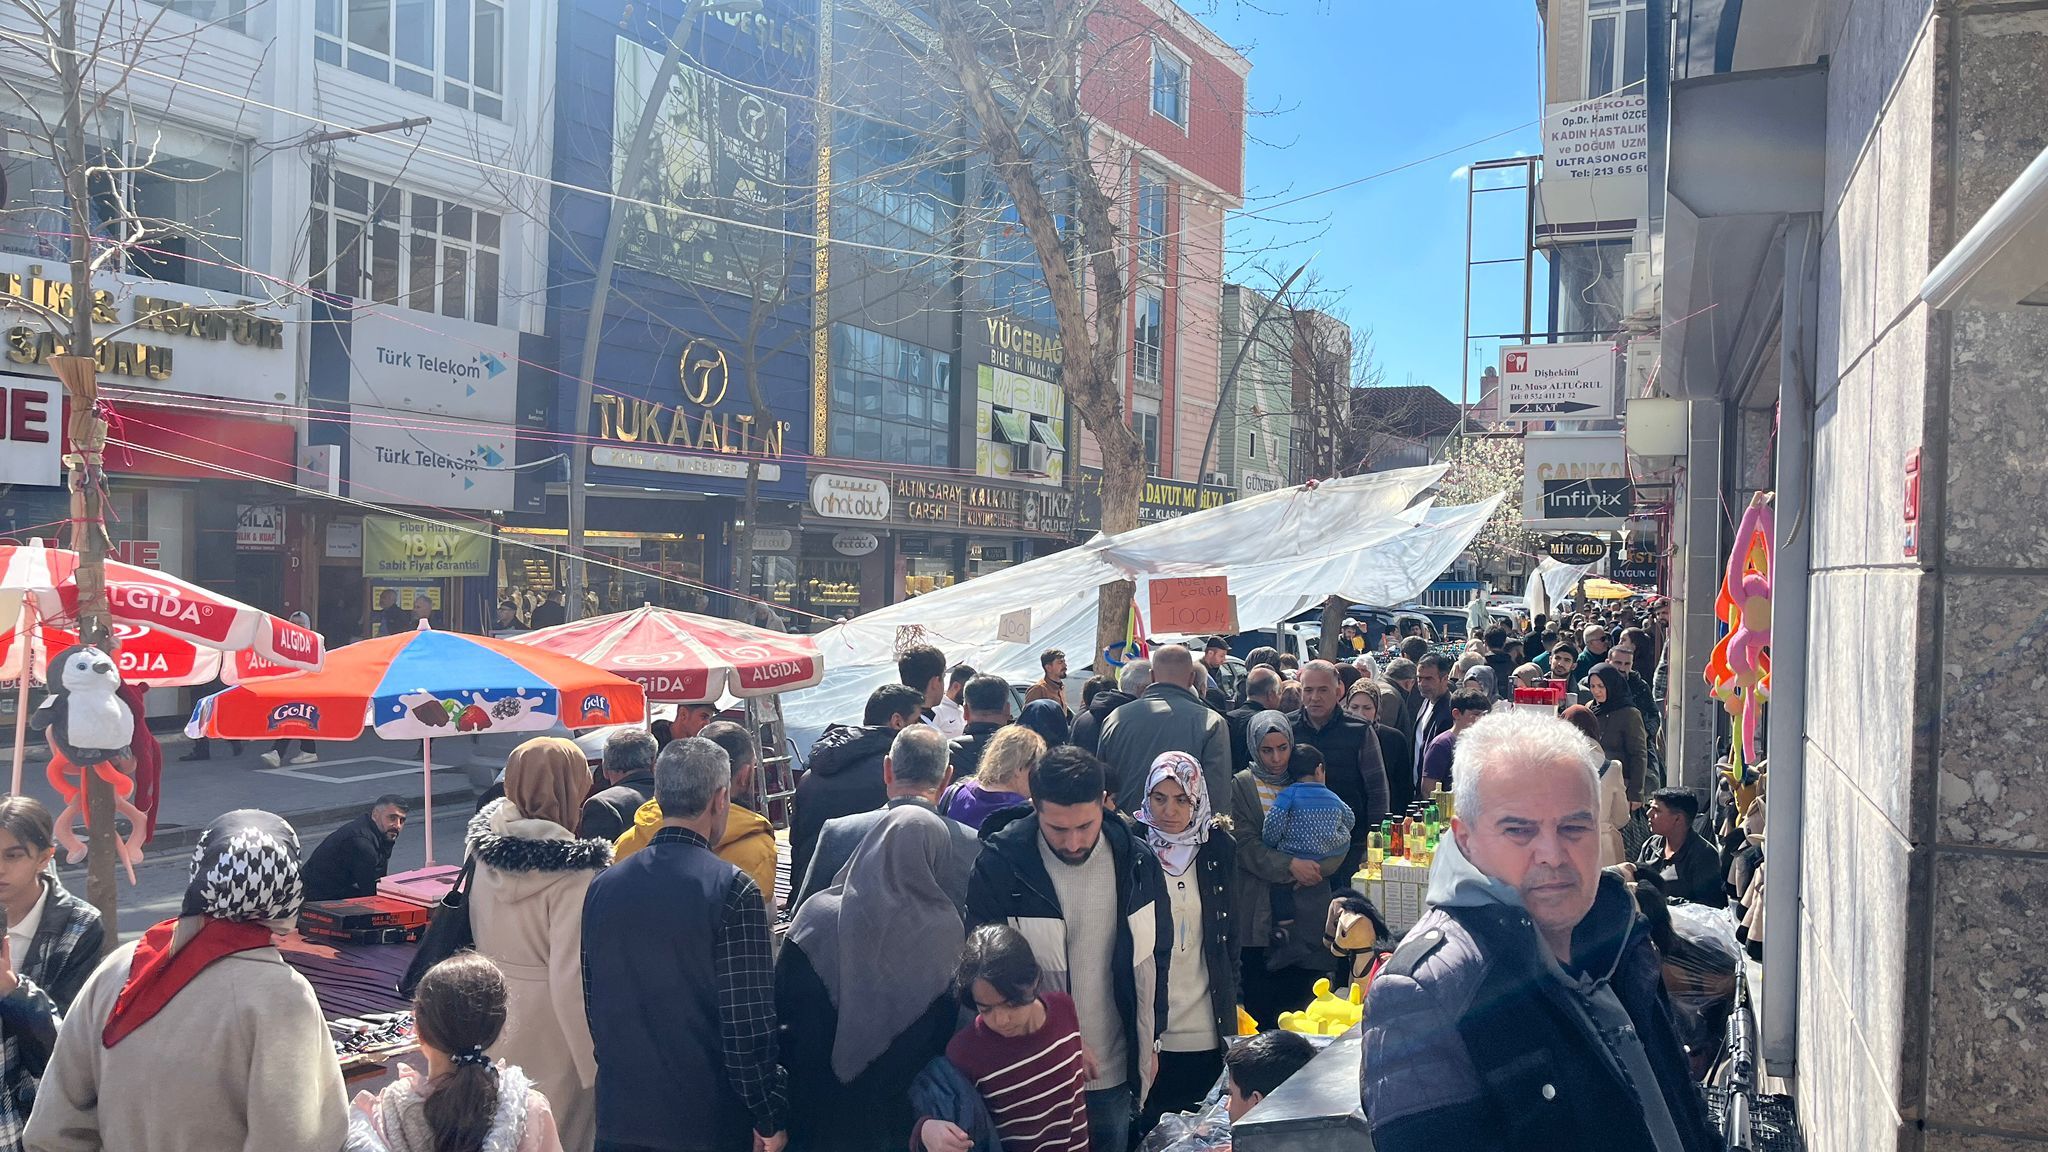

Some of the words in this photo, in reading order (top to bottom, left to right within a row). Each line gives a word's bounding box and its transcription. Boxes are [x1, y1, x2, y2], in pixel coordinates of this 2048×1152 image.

[1562, 115, 1589, 127] Op.Dr.
[1592, 112, 1619, 123] Hamit
[1551, 130, 1587, 141] KADIN
[1590, 123, 1646, 138] HASTALIK
[1560, 146, 1572, 154] ve
[1575, 140, 1615, 153] DOĞUM
[1621, 137, 1646, 148] UZM
[1556, 151, 1647, 167] ULTRASONOGR
[1570, 169, 1591, 178] Tel:
[1594, 166, 1614, 176] 213
[1618, 165, 1632, 174] 65
[986, 315, 1063, 365] YÜCEBAĞ
[7, 325, 174, 381] SAONU
[991, 347, 1024, 372] BİLEİK
[376, 346, 412, 369] Türk
[417, 353, 481, 379] Telekom
[1534, 367, 1579, 379] Dişhekimi
[1549, 380, 1604, 390] ALTUĞRUL
[1536, 403, 1559, 412] KAT
[375, 446, 410, 465] Türk
[415, 450, 479, 472] Telekom
[899, 480, 926, 497] ALTIN
[928, 482, 962, 501] SARAY
[969, 486, 1017, 510] KALKAN
[1146, 482, 1181, 508] DAVUT
[1550, 489, 1622, 507] Infinix
[400, 521, 425, 532] Fiber
[401, 534, 427, 557] 18
[431, 534, 461, 557] AY
[1551, 542, 1574, 555] MİM
[1576, 544, 1603, 555] GOLD
[379, 560, 406, 571] Sabit
[409, 560, 434, 572] Fiyat
[436, 560, 480, 570] Garantisi
[1613, 569, 1646, 578] UYGUN
[1166, 606, 1211, 626] 100
[273, 703, 315, 720] Golf
[584, 695, 606, 711] Golf
